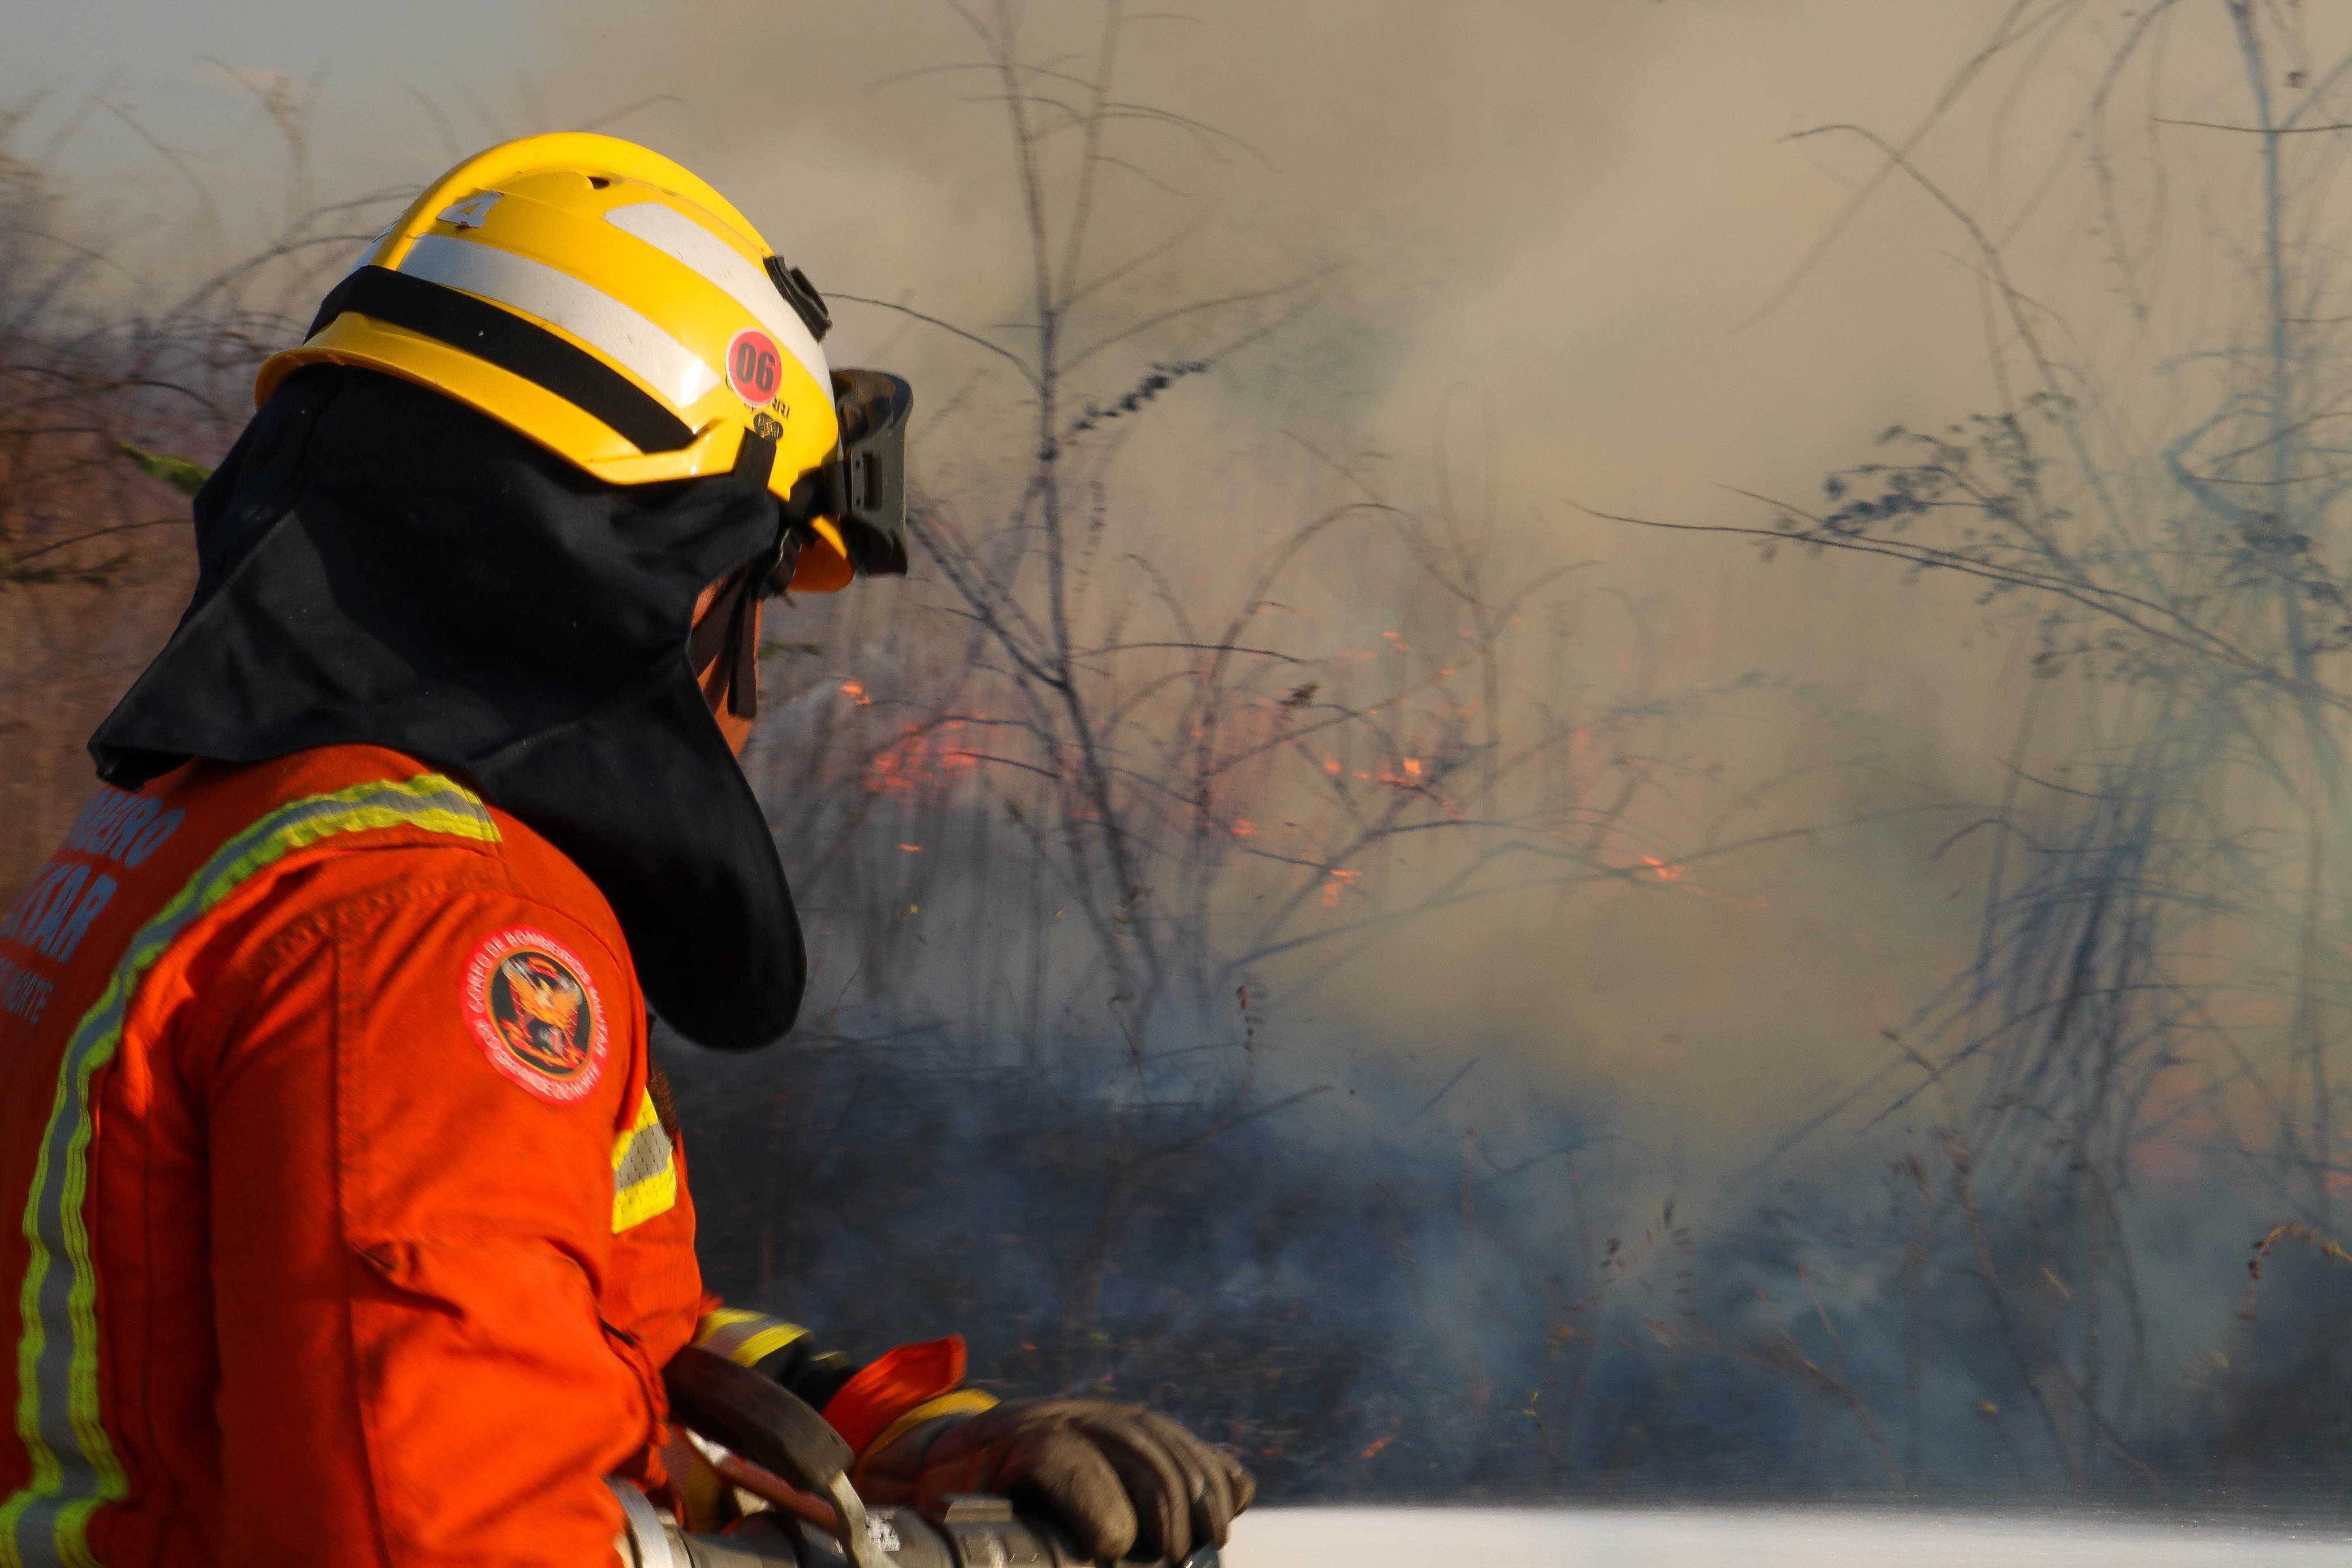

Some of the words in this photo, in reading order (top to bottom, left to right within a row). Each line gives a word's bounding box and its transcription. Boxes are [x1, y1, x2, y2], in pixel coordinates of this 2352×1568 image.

[736, 341, 776, 393] 06
[466, 951, 493, 1013] CORPO
[482, 935, 509, 959] DE
[502, 929, 592, 985] BOMBEIROS
